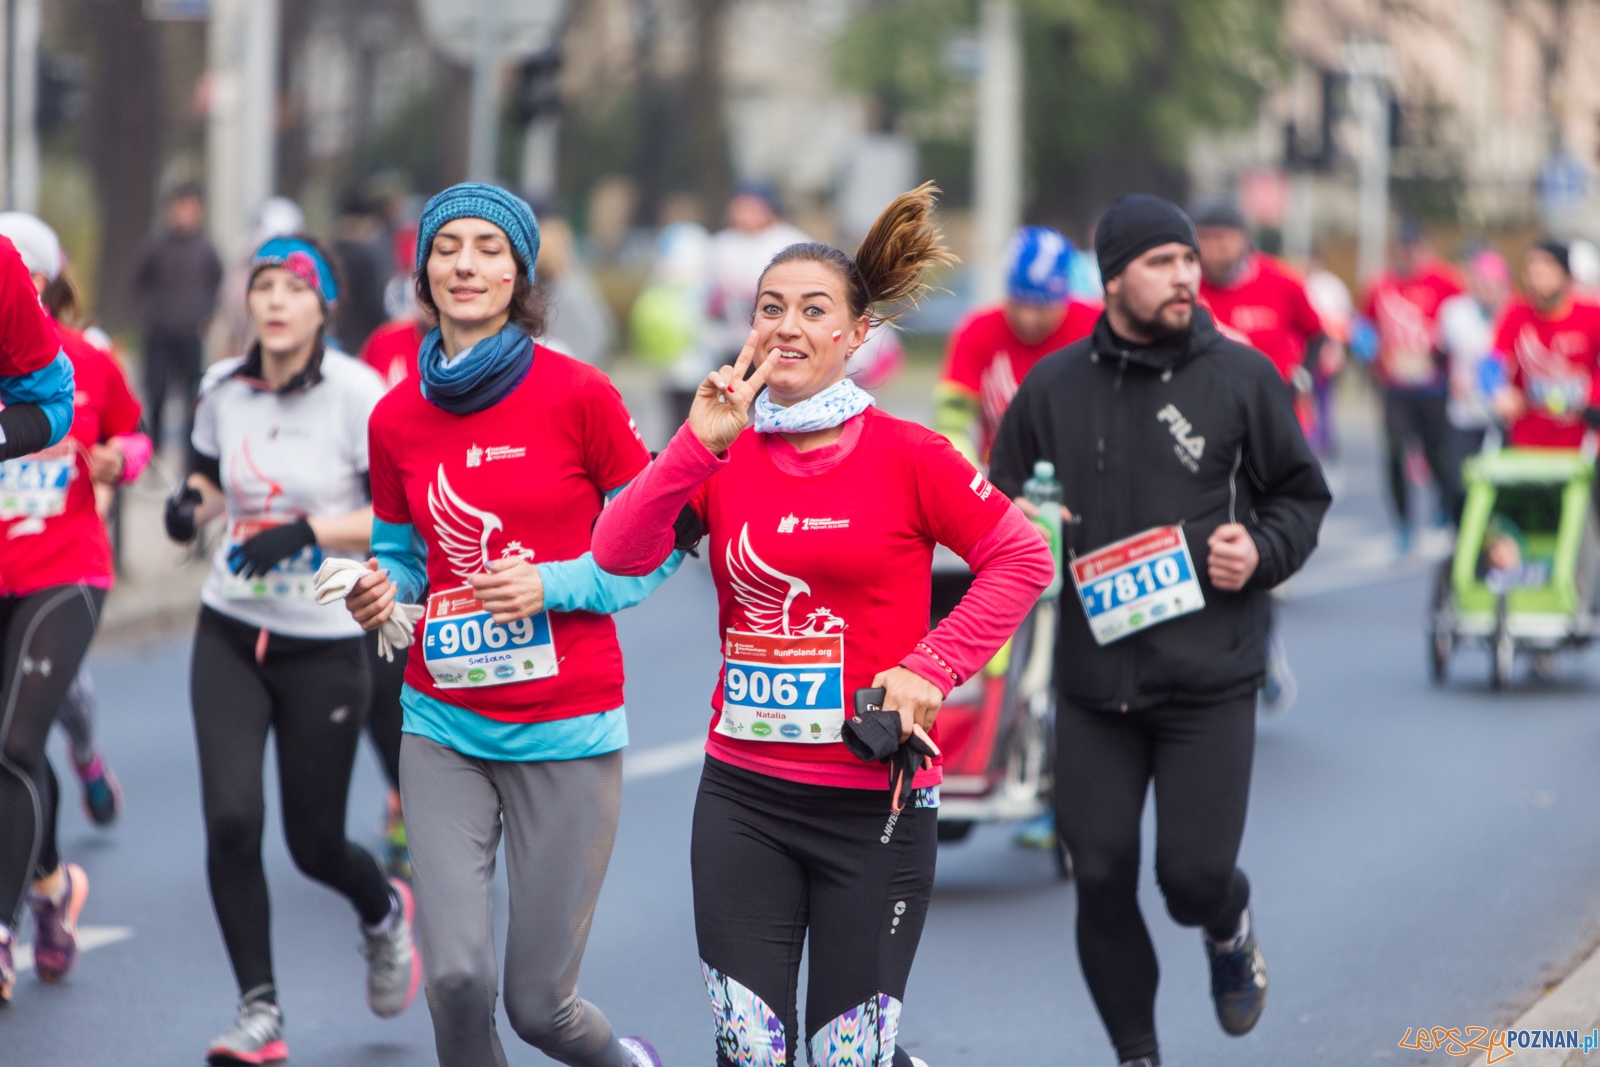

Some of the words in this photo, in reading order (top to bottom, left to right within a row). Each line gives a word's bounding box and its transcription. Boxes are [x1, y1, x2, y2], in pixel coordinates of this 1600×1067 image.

[1157, 404, 1205, 460] FILA
[1093, 556, 1180, 610] 7810
[439, 617, 534, 654] 9069
[774, 648, 832, 657] RunPoland.org
[728, 668, 826, 706] 9067
[756, 711, 786, 719] Natalia
